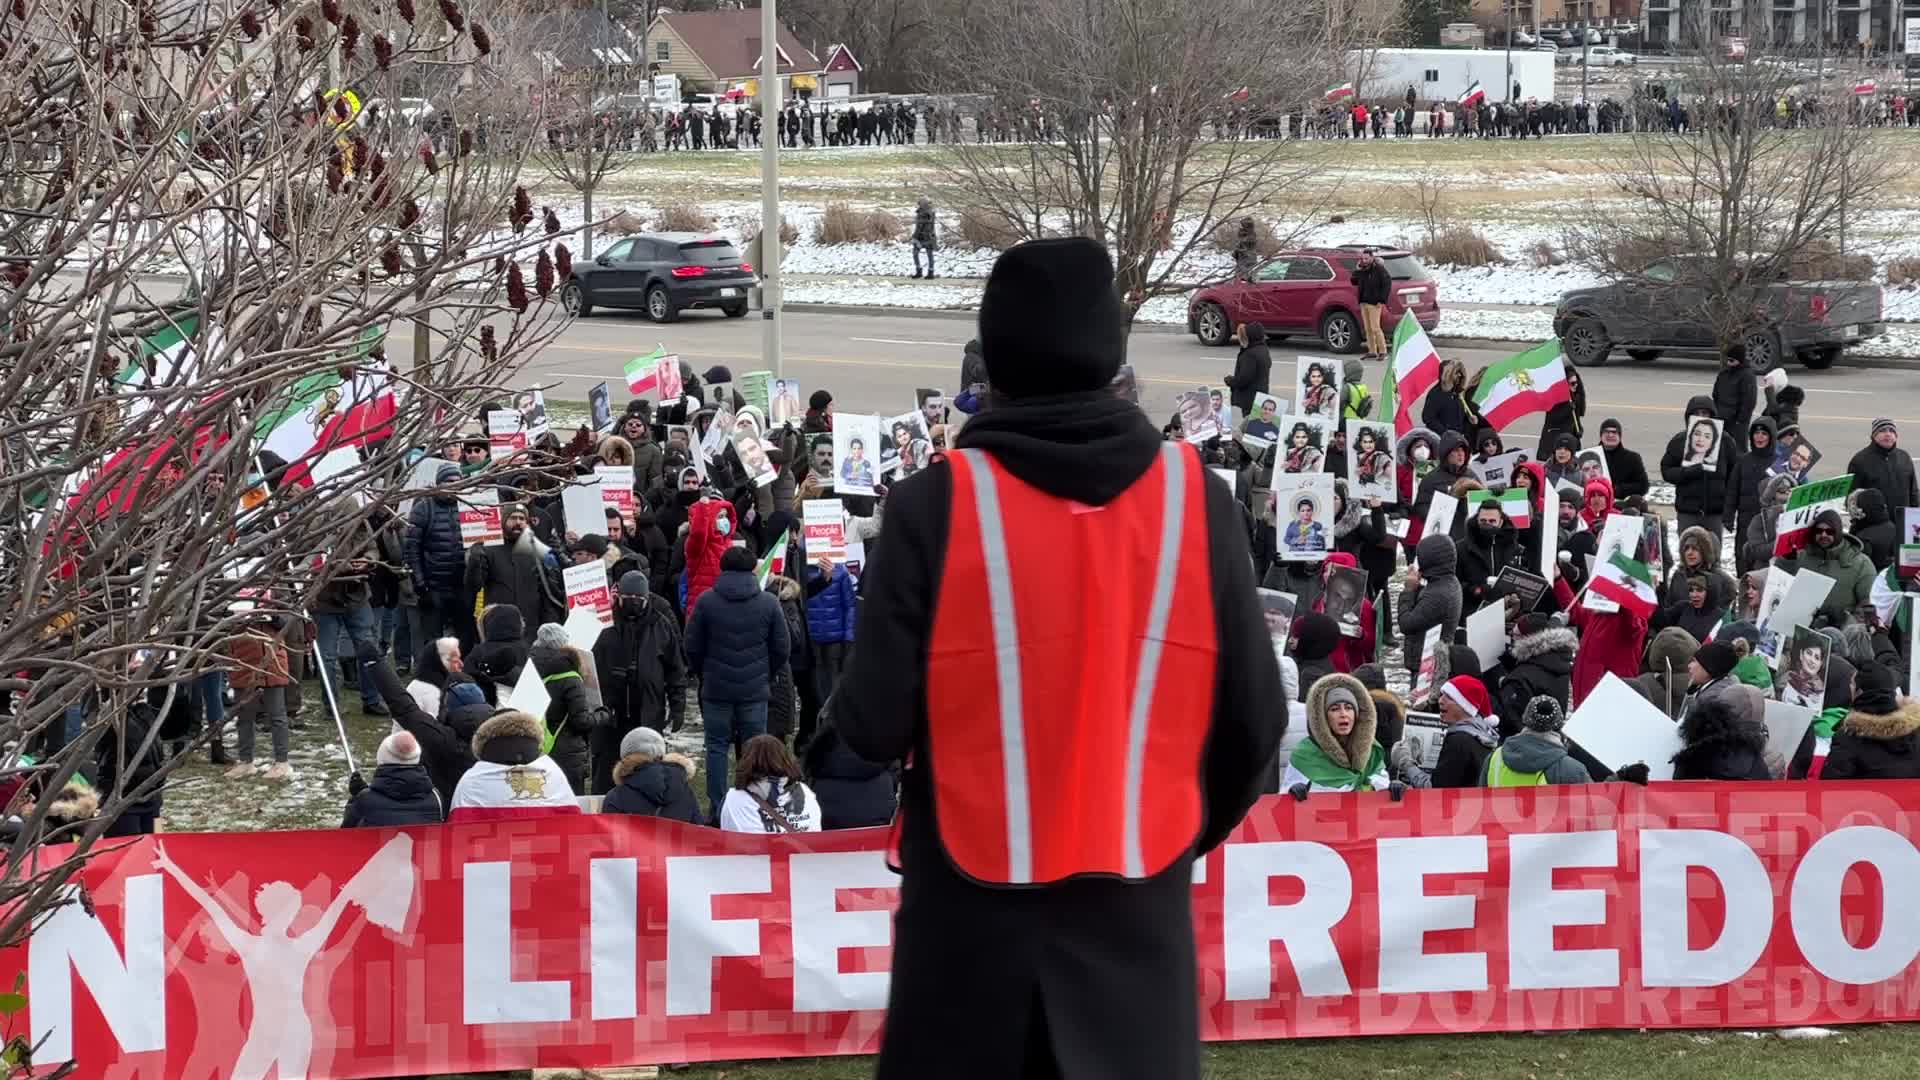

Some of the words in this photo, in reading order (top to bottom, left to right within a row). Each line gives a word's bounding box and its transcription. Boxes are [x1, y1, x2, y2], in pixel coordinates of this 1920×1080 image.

[465, 510, 495, 521] Peope
[810, 526, 840, 537] People
[574, 590, 603, 604] People
[463, 850, 903, 1025] LIFE
[1191, 825, 1920, 1002] REEDO
